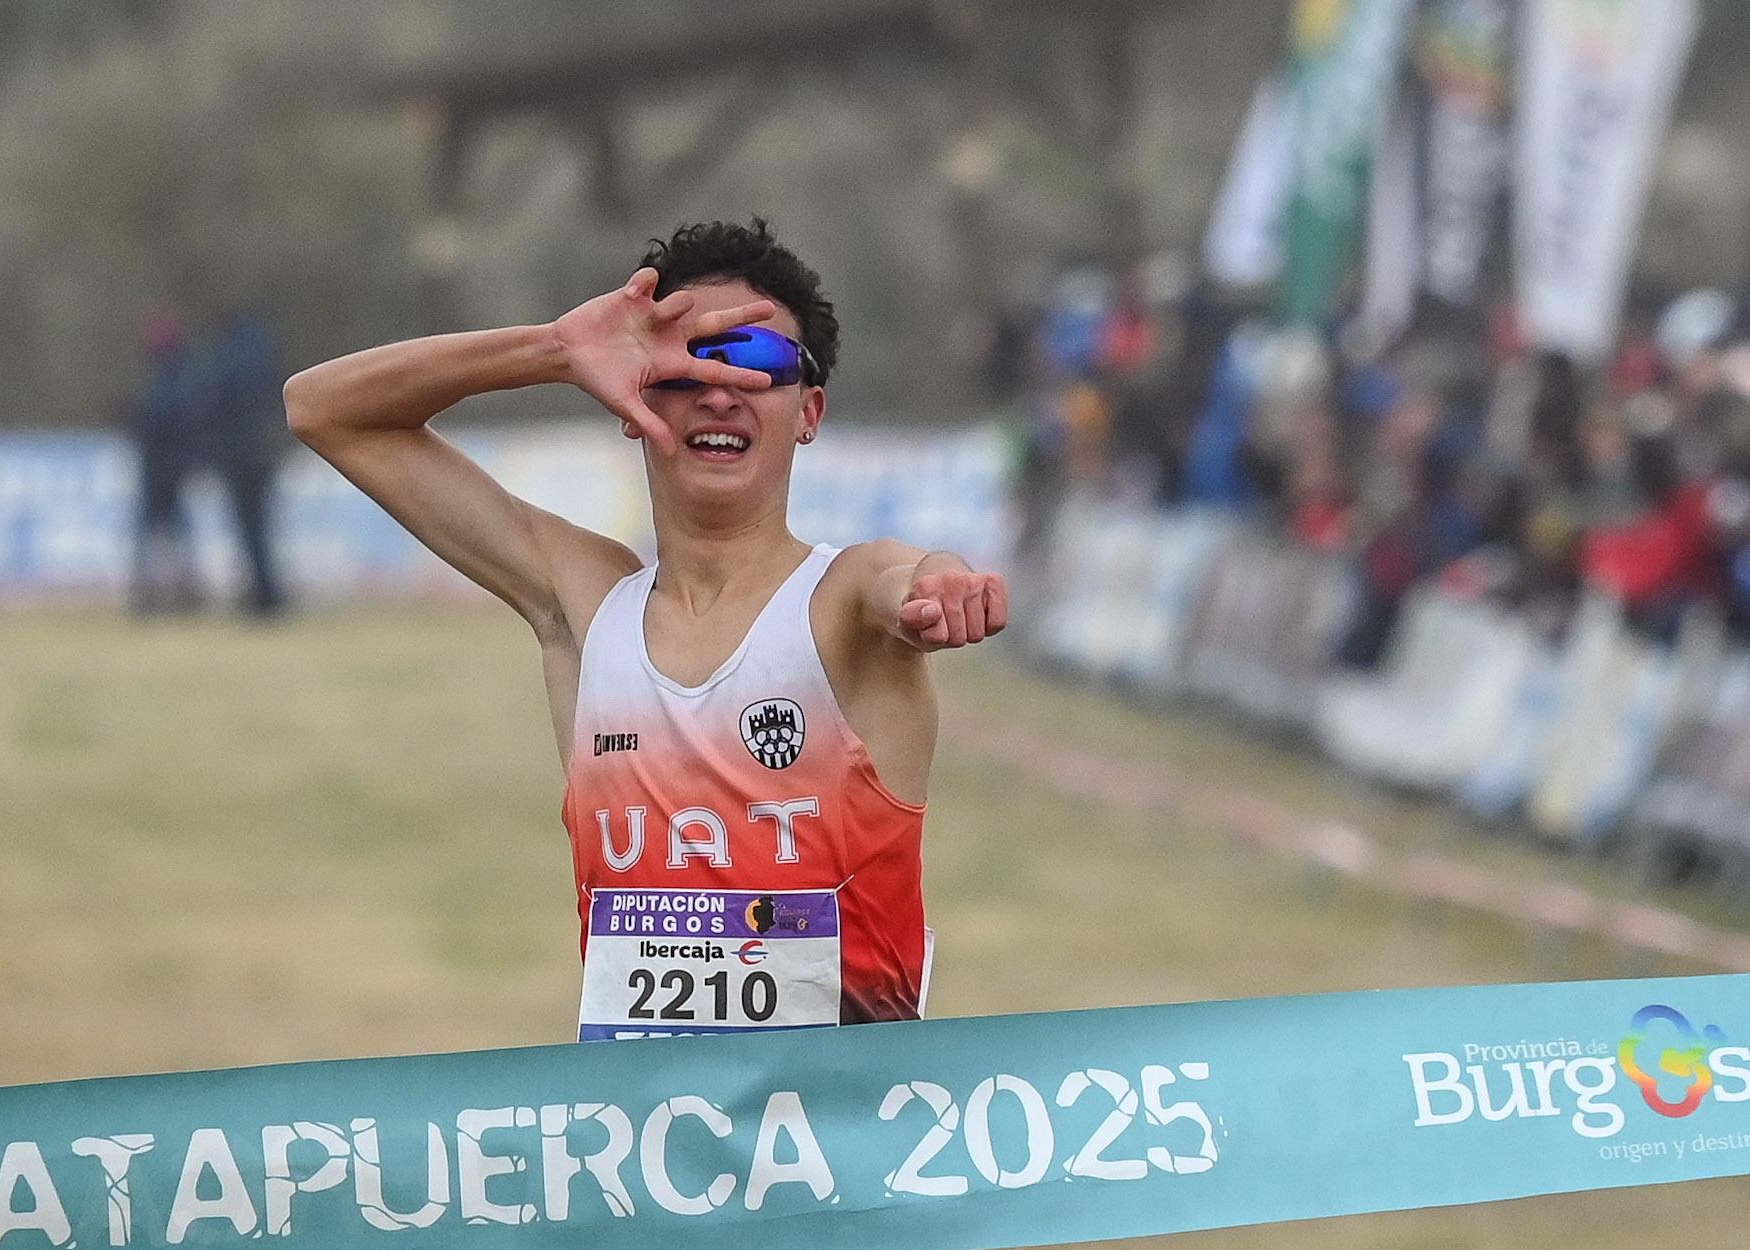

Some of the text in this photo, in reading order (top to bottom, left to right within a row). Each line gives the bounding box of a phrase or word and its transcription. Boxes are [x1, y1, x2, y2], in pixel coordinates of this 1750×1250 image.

[595, 796, 820, 873] UAT
[612, 893, 725, 913] DIPUTACIÓN
[609, 915, 725, 934] BURGOS
[640, 941, 725, 963] Ibercaja
[627, 968, 778, 1022] 2210
[1464, 1037, 1610, 1063] Provincia de
[877, 1062, 1221, 1199] 2025
[1599, 1141, 1667, 1163] origen
[1673, 1140, 1684, 1159] y
